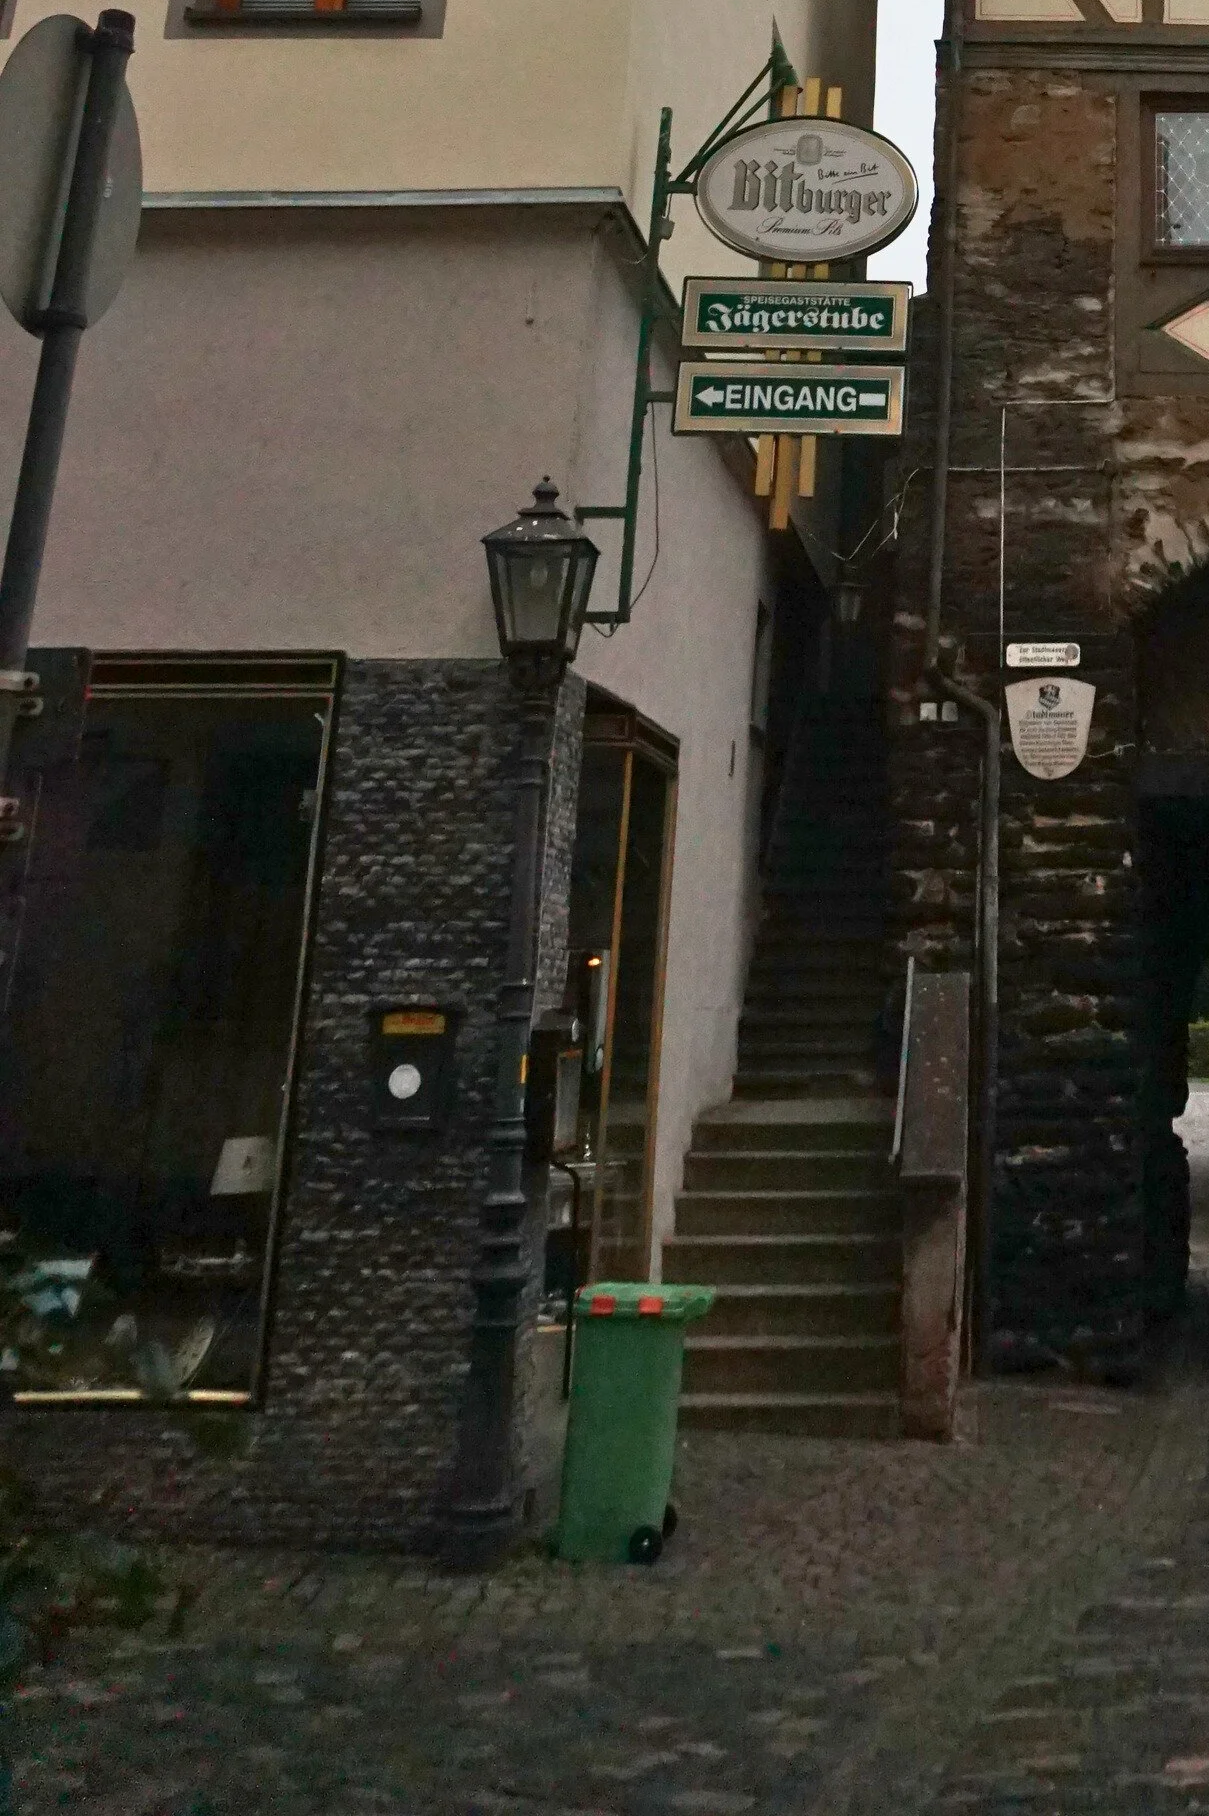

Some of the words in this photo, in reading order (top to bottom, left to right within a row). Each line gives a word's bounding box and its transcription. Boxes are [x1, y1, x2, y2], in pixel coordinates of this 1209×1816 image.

[727, 159, 892, 224] Bitburger
[756, 216, 811, 235] Premium
[812, 218, 844, 236] Pils
[706, 302, 886, 333] Jägerstube
[724, 384, 857, 412] EINGANG
